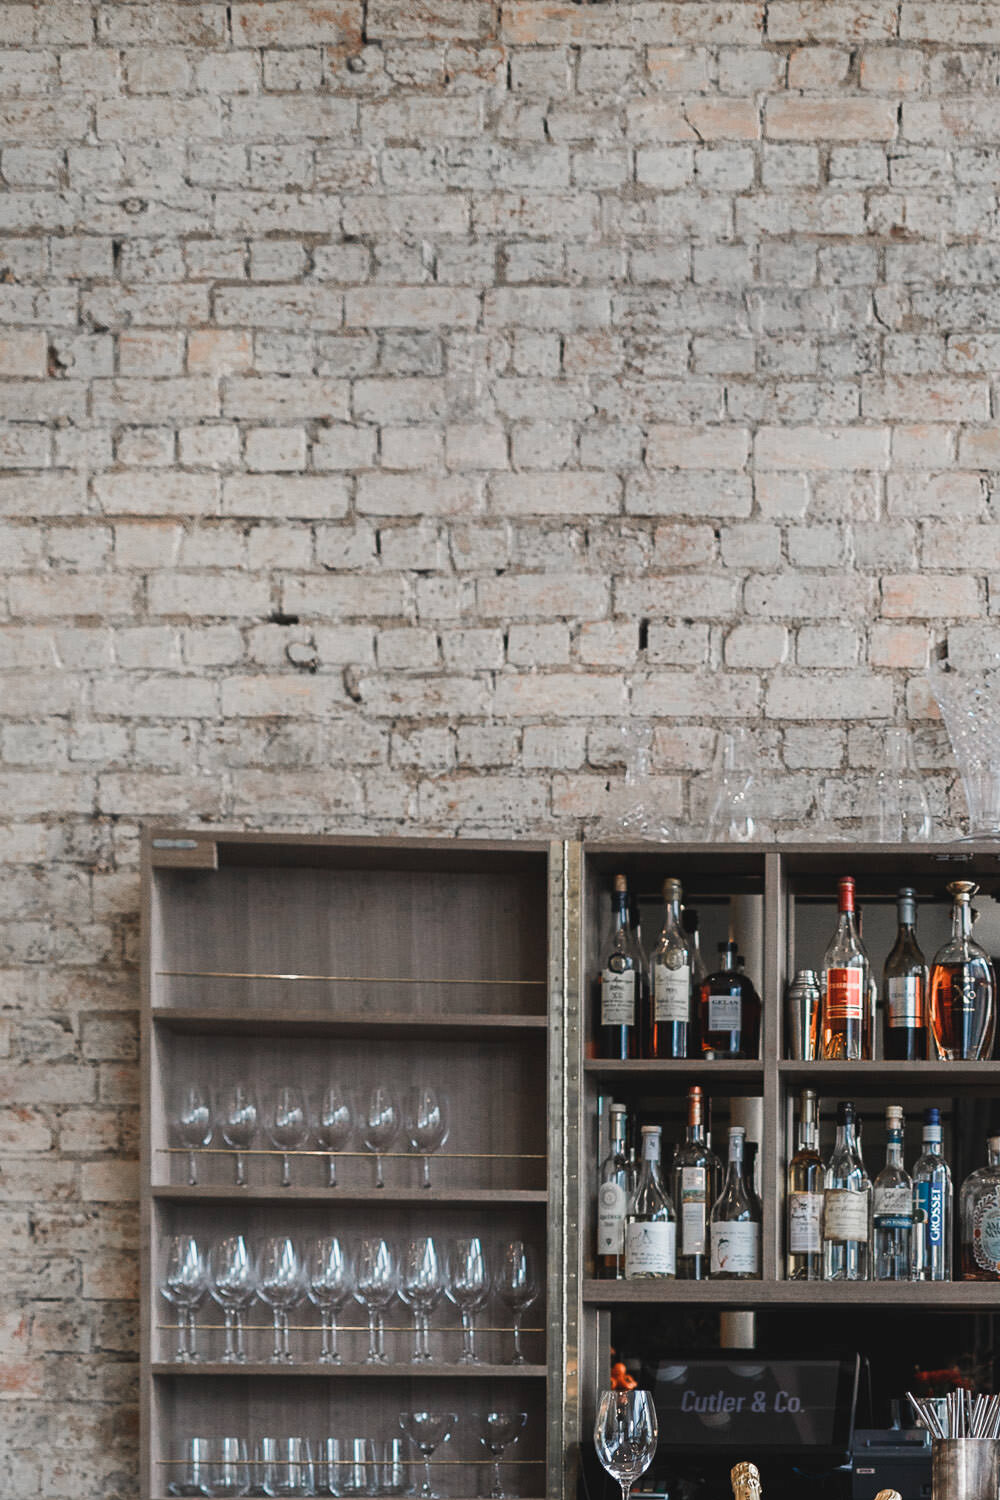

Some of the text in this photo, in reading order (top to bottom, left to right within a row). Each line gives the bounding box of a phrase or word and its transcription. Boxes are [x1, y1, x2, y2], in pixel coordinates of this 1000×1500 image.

[930, 1188, 941, 1241] GROSSET
[681, 1390, 805, 1413] Cutler & Co.
